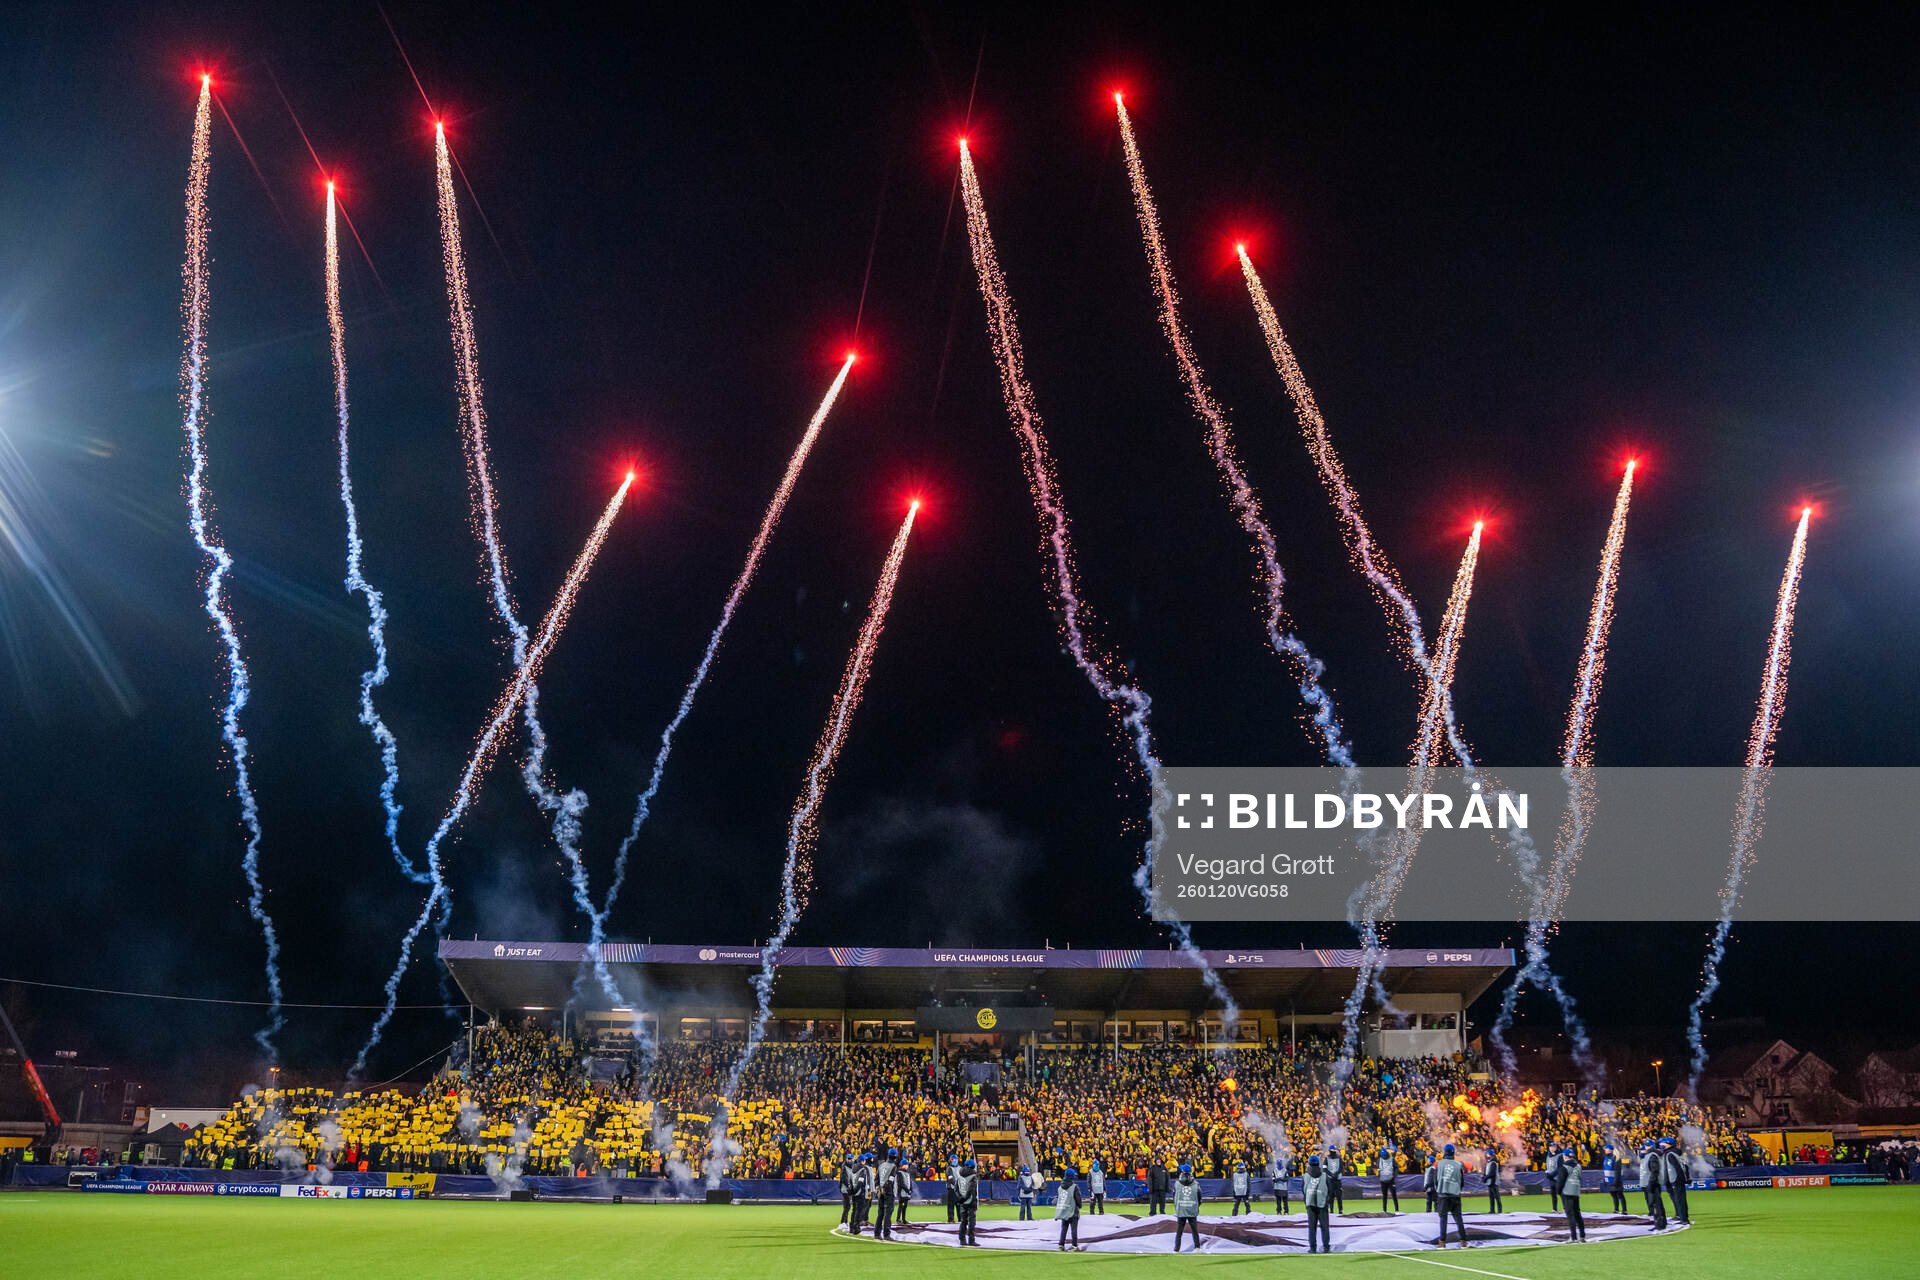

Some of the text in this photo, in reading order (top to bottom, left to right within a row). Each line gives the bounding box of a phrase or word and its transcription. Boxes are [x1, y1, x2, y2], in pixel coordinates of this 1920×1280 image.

[506, 948, 526, 957] JUST
[719, 951, 760, 959] mastercard
[934, 954, 1044, 963] UEFA CHAMPIONS LEAGUE
[1238, 955, 1264, 963] PS5
[1443, 953, 1472, 962] PEPSI
[1728, 1179, 1772, 1187] mastercard
[1787, 1177, 1825, 1187] JUST EAT
[147, 1183, 214, 1193] QATAR AIRWAYS
[229, 1185, 278, 1195] crypto.com
[297, 1185, 329, 1198] FedEx
[364, 1188, 396, 1198] PEPSI
